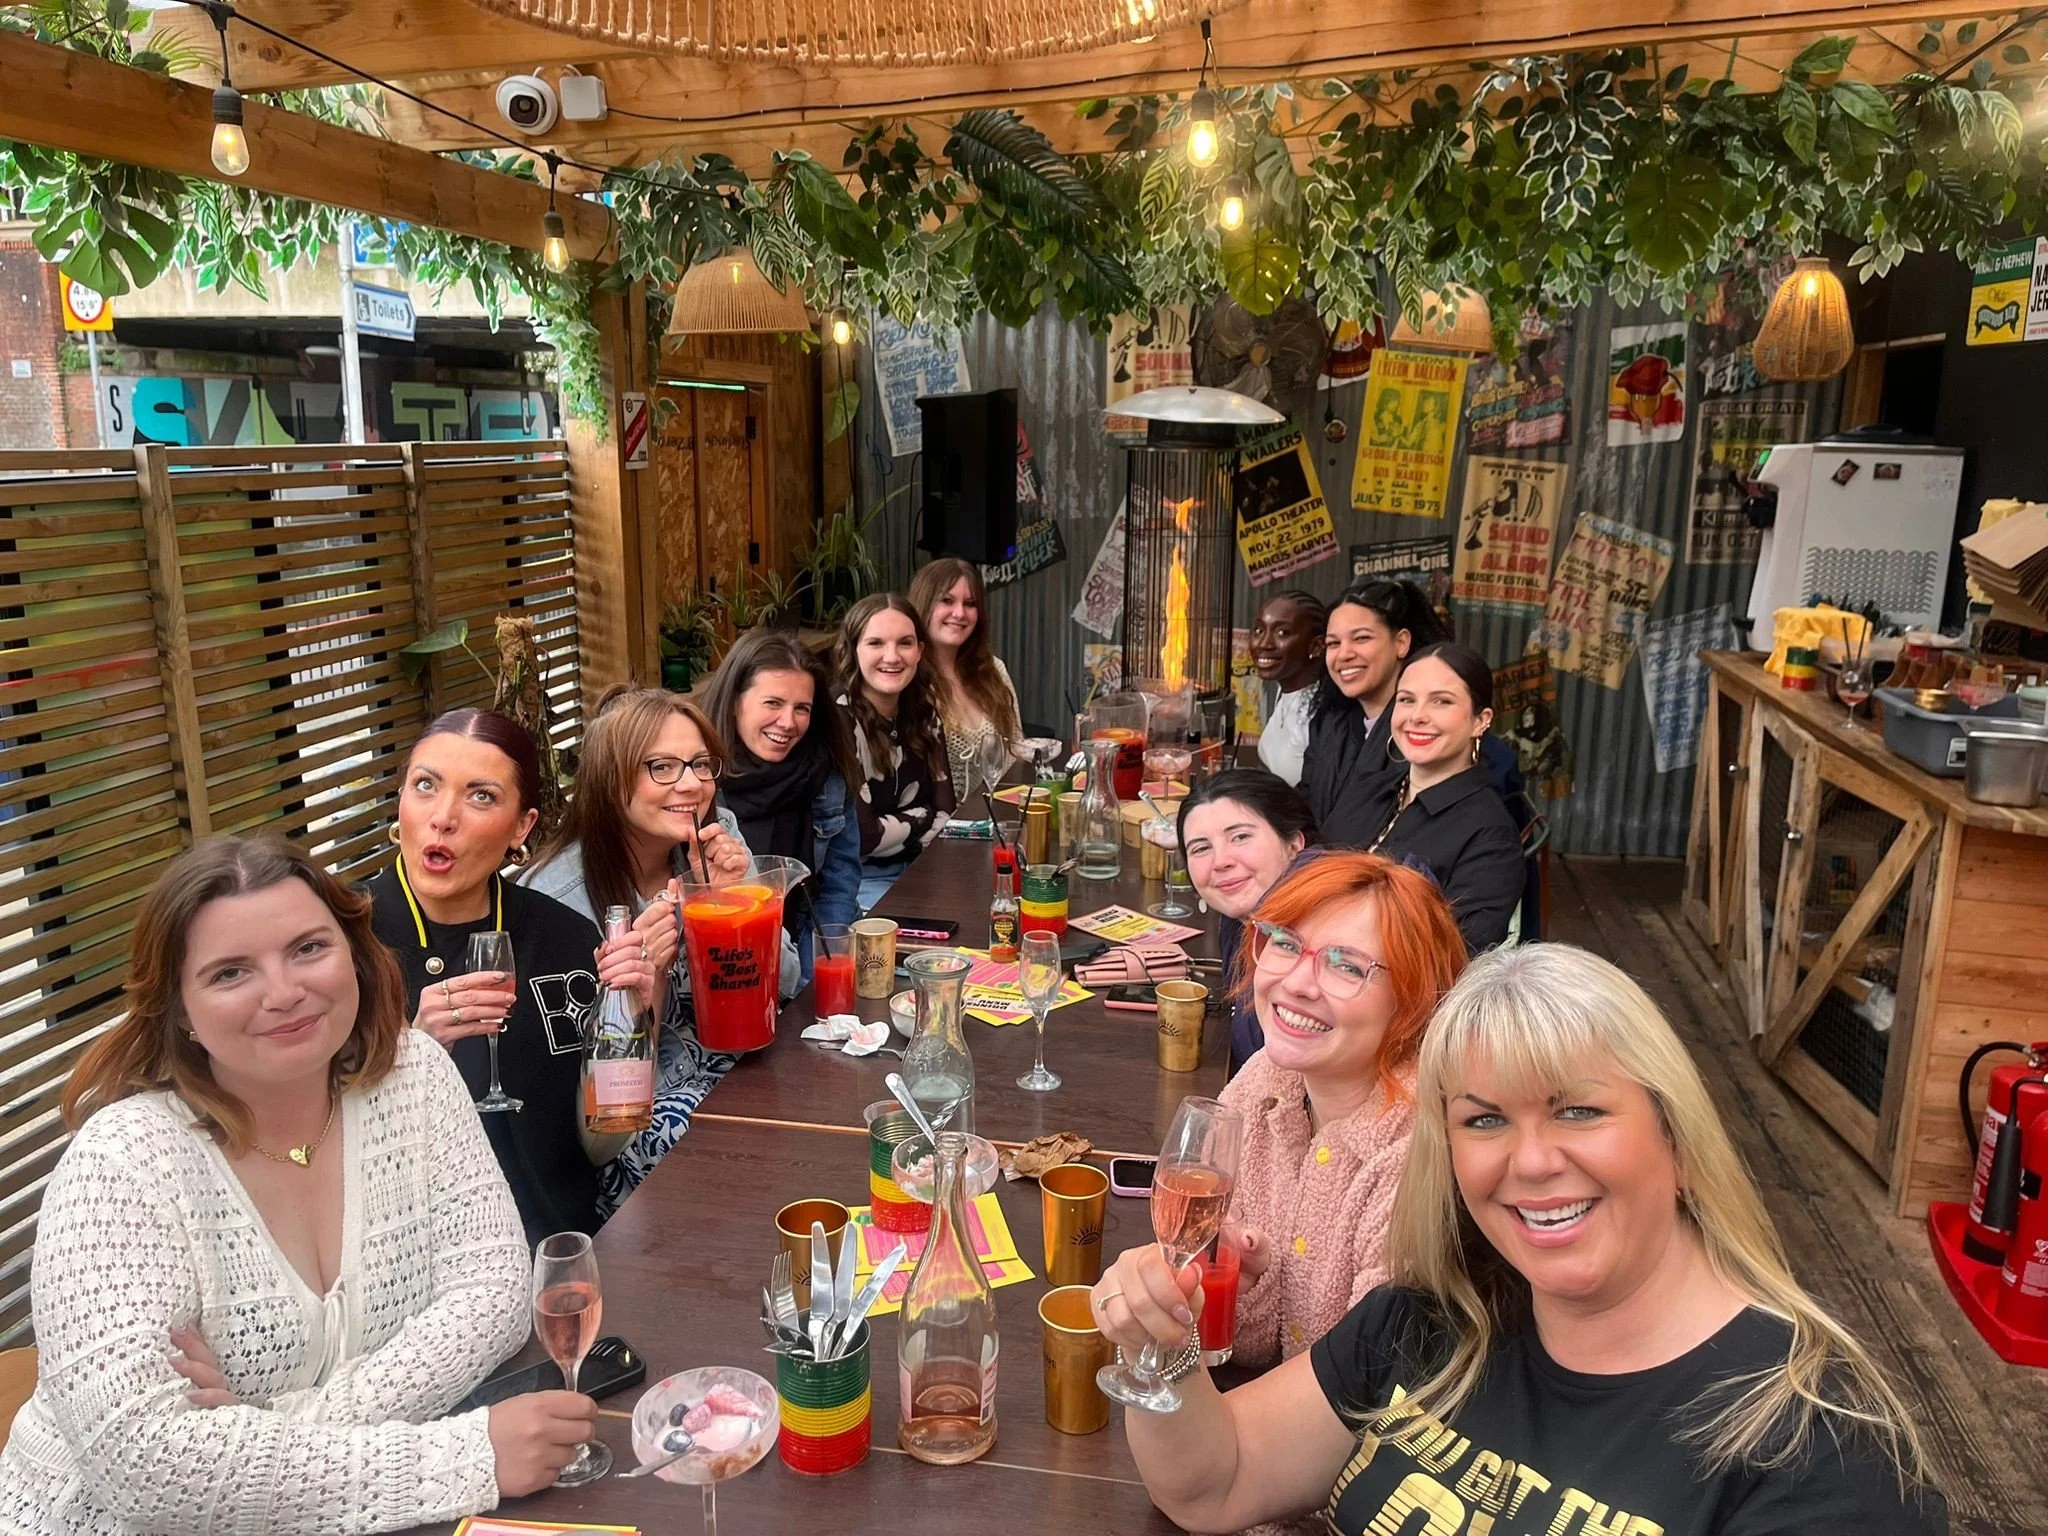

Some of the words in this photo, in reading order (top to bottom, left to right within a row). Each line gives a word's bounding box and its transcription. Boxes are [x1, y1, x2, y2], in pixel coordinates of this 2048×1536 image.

[2001, 250, 2034, 270] NEPHEW
[371, 300, 405, 321] Toilets
[1246, 430, 1303, 463] WAILERS
[1394, 468, 1430, 483] MARLEY
[1354, 491, 1384, 505] JULY
[1390, 495, 1403, 508] 15
[1413, 498, 1441, 512] 1975
[1239, 515, 1278, 540] APOLLO
[1278, 496, 1325, 523] THEATER
[1248, 538, 1276, 556] NOV.
[1277, 531, 1293, 544] 22
[1300, 516, 1325, 534] 1979
[1488, 523, 1550, 545] SOUND
[1015, 540, 1059, 579] KILLER
[1248, 550, 1291, 574] MARCUS
[1293, 530, 1334, 556] GARVEY
[1354, 552, 1421, 576] CHANNEL
[1421, 553, 1450, 572] ONE
[1480, 551, 1548, 576] ALARM
[1464, 571, 1495, 584] MUSIC
[1496, 573, 1541, 588] FESTIVAL
[708, 946, 755, 962] Life's
[720, 962, 758, 977] Best
[709, 973, 761, 990] Shared
[966, 1001, 1009, 1010] DRINKS
[609, 1079, 643, 1088] PROSECCO
[1372, 1383, 1472, 1475] YOU
[1455, 1448, 1552, 1521] GOT
